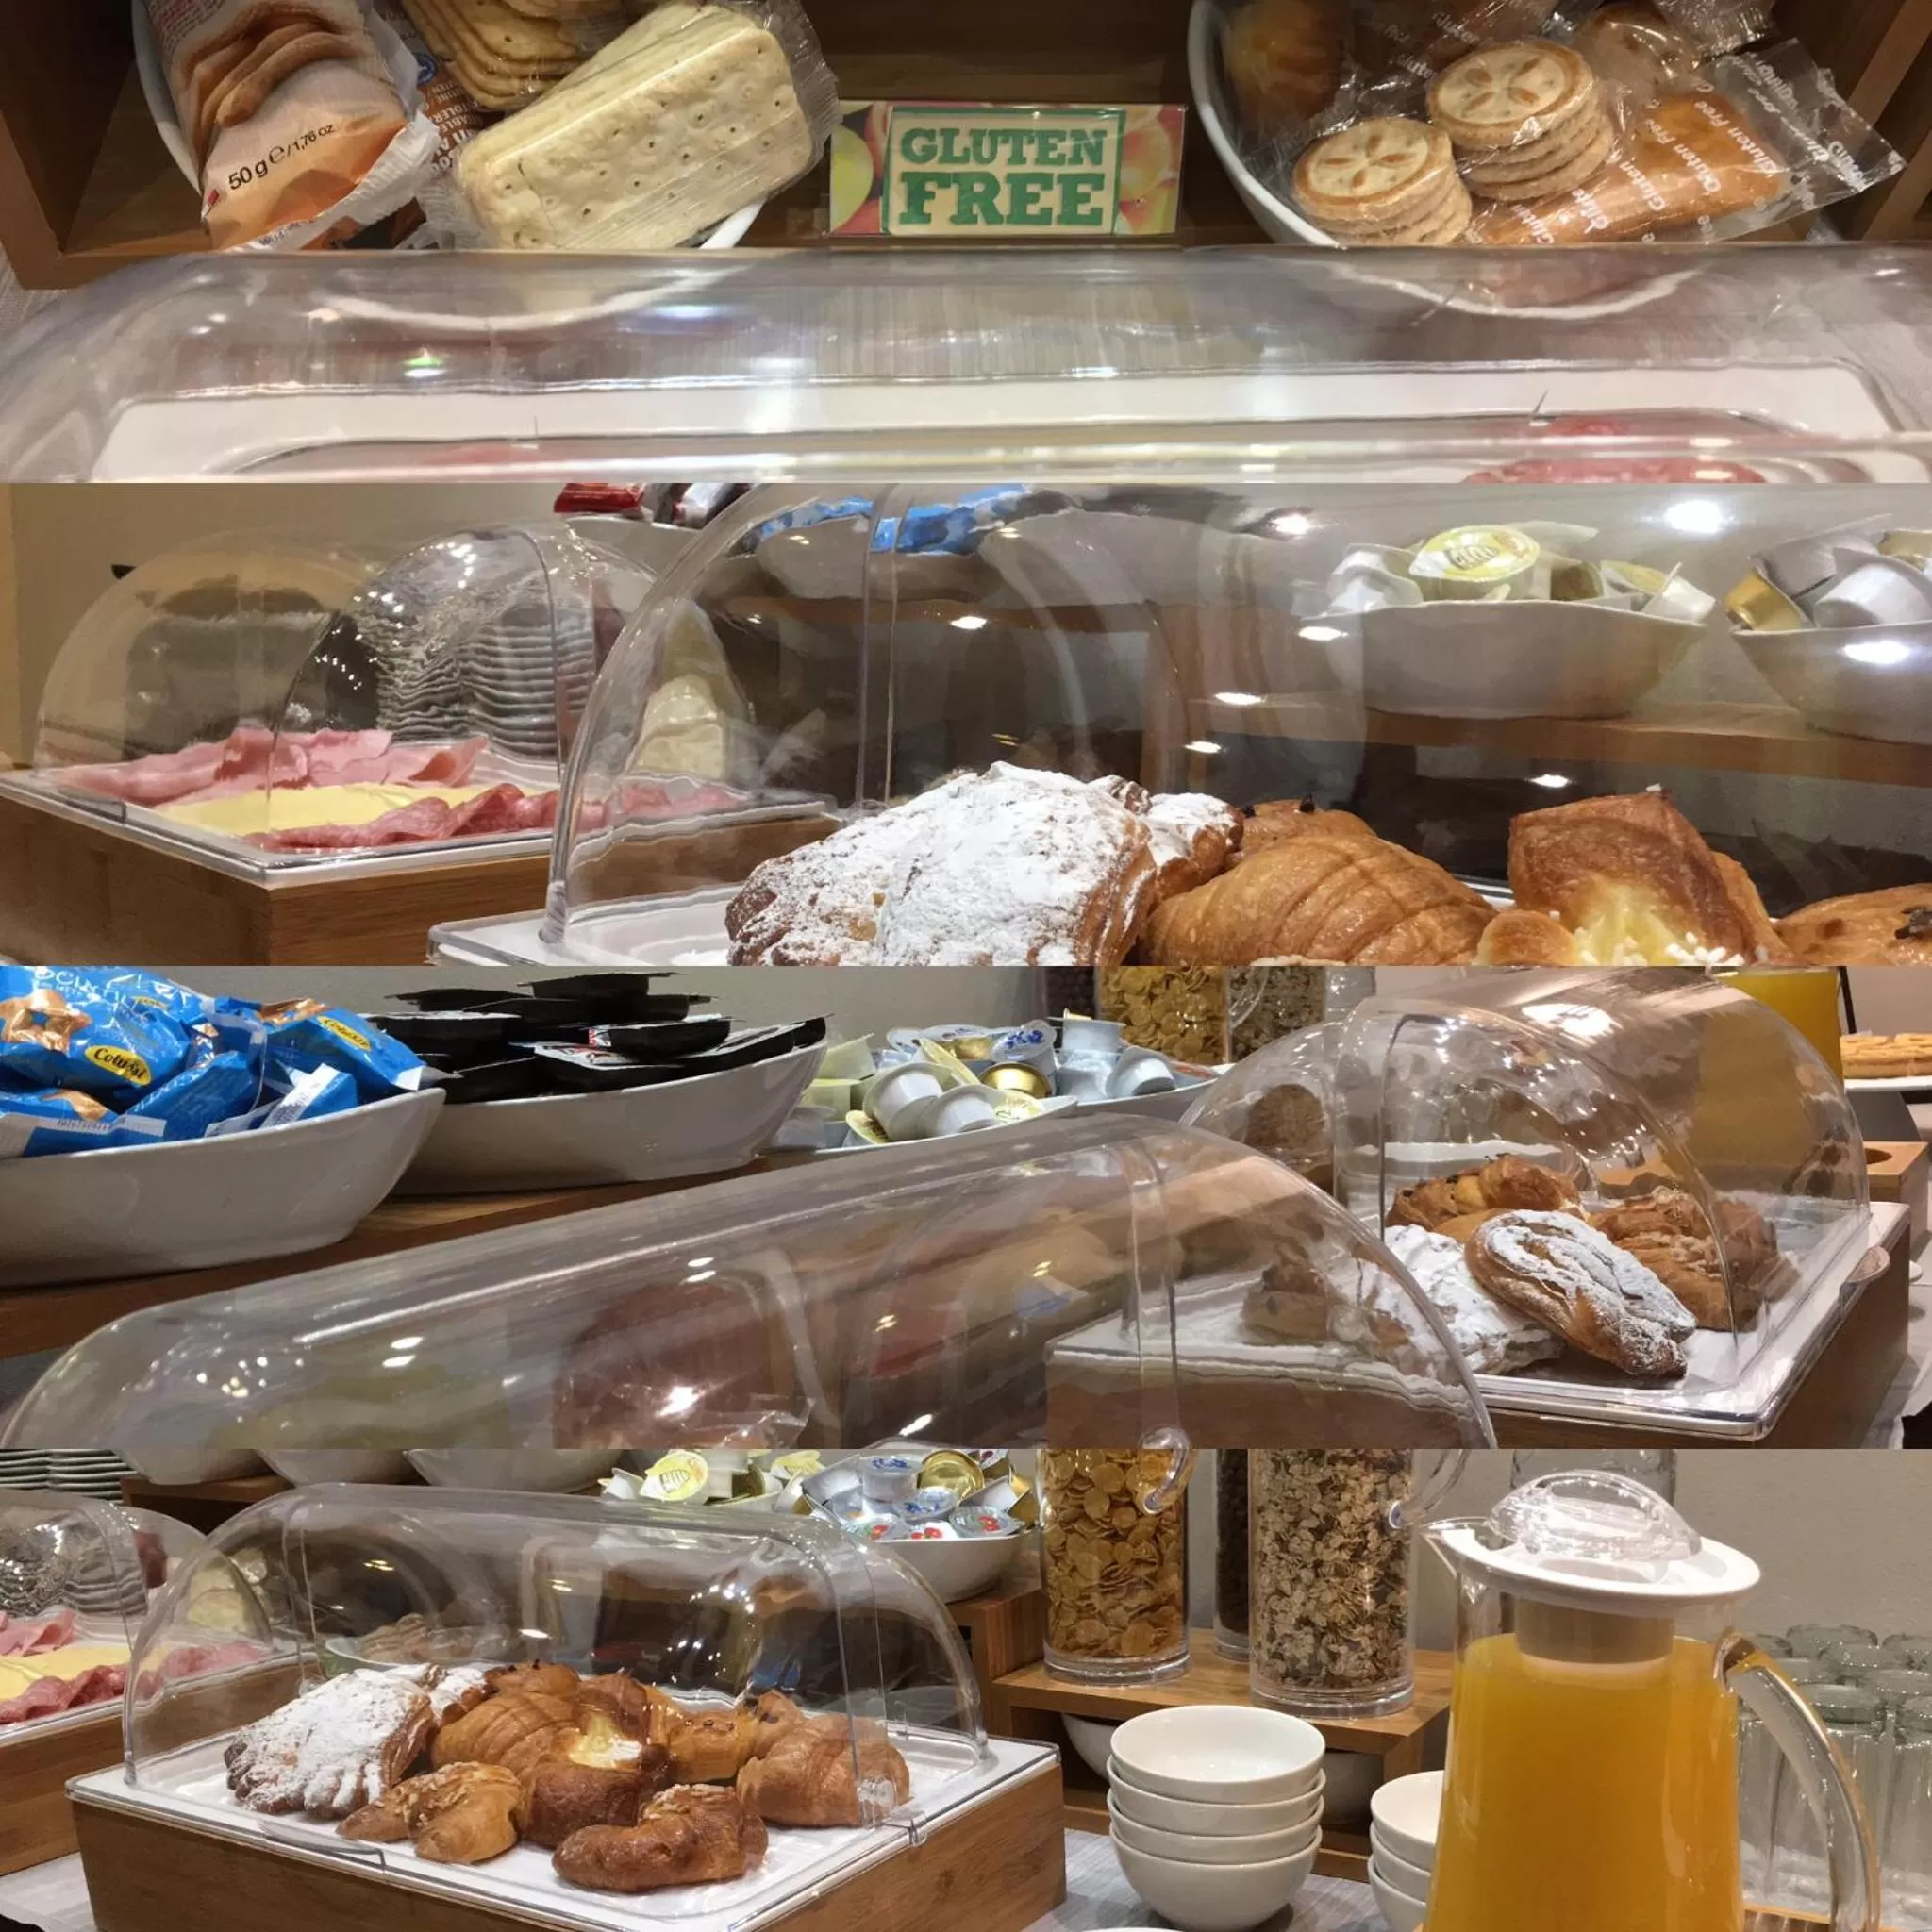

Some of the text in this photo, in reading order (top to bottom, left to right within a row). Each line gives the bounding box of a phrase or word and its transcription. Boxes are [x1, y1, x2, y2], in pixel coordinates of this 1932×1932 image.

[1694, 100, 1730, 127] Free
[900, 127, 1108, 166] GLUTEN
[1673, 142, 1722, 193] Gluten
[1728, 126, 1779, 174] Gluten
[228, 166, 253, 190] 50
[899, 171, 1106, 226] FREE
[1619, 160, 1666, 211] Gluten
